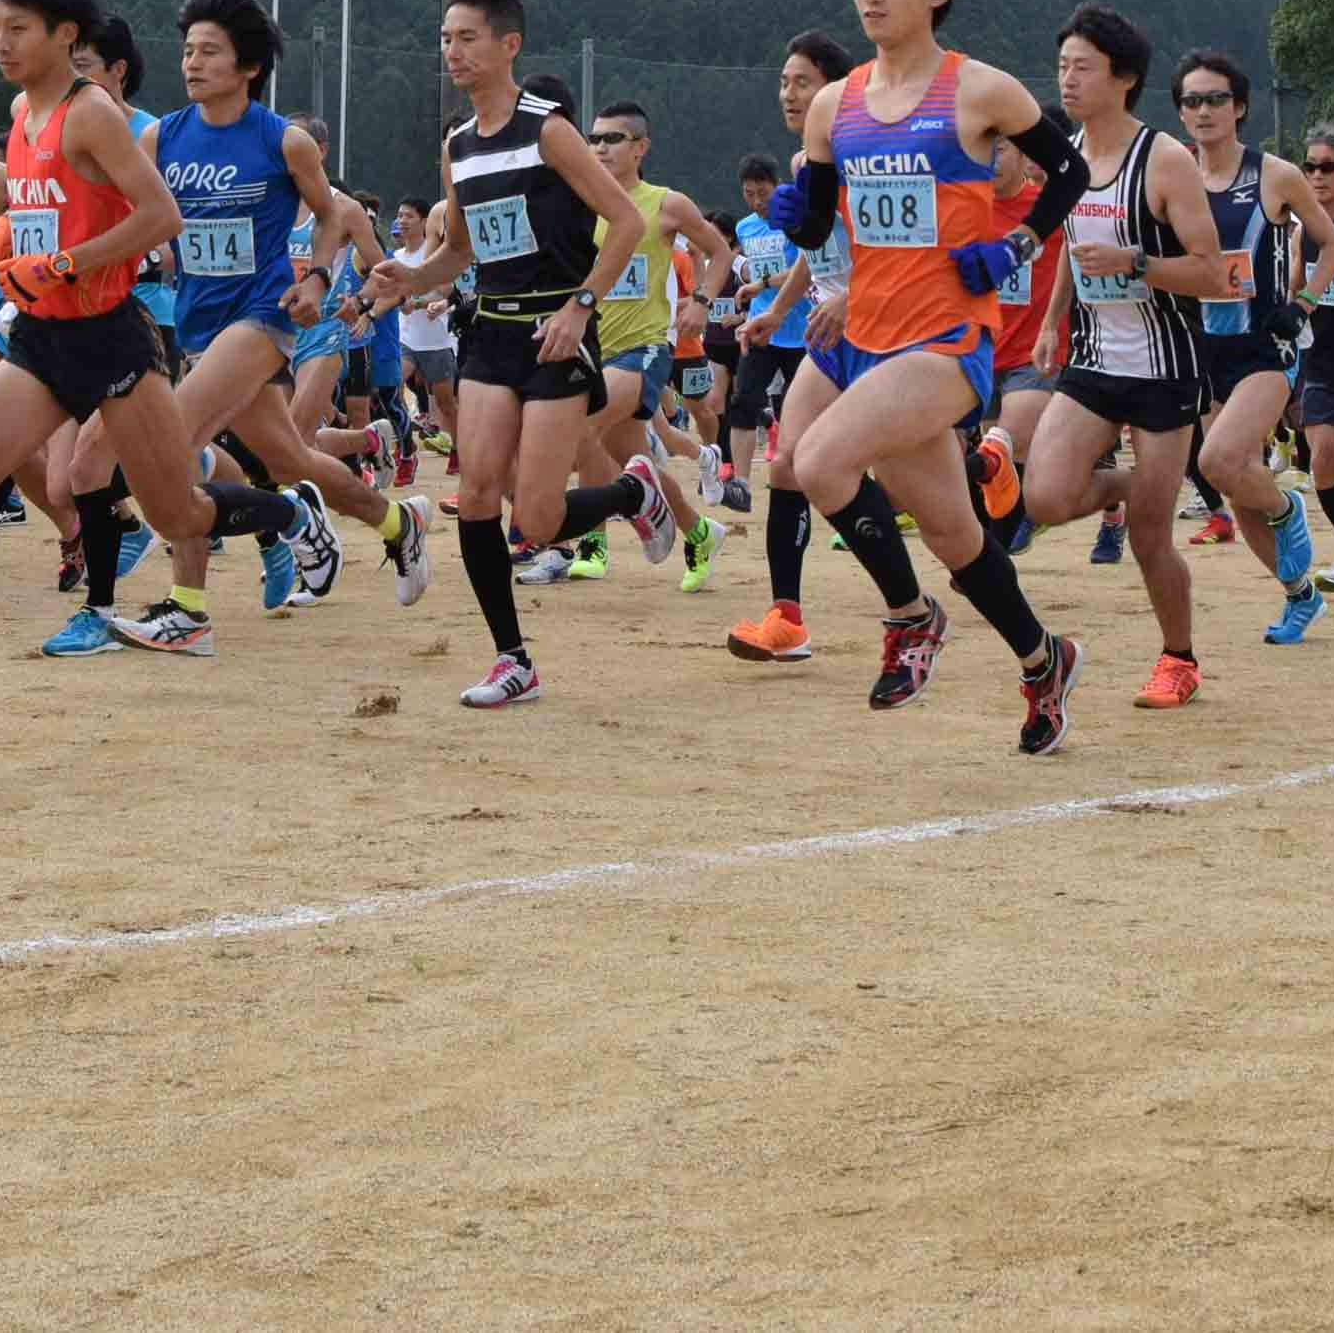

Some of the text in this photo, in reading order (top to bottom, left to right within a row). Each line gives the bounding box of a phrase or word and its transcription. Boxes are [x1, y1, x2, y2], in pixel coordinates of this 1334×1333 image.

[844, 154, 932, 175] NICHIA
[858, 194, 918, 229] 608
[478, 211, 520, 246] 497
[187, 233, 238, 261] 514
